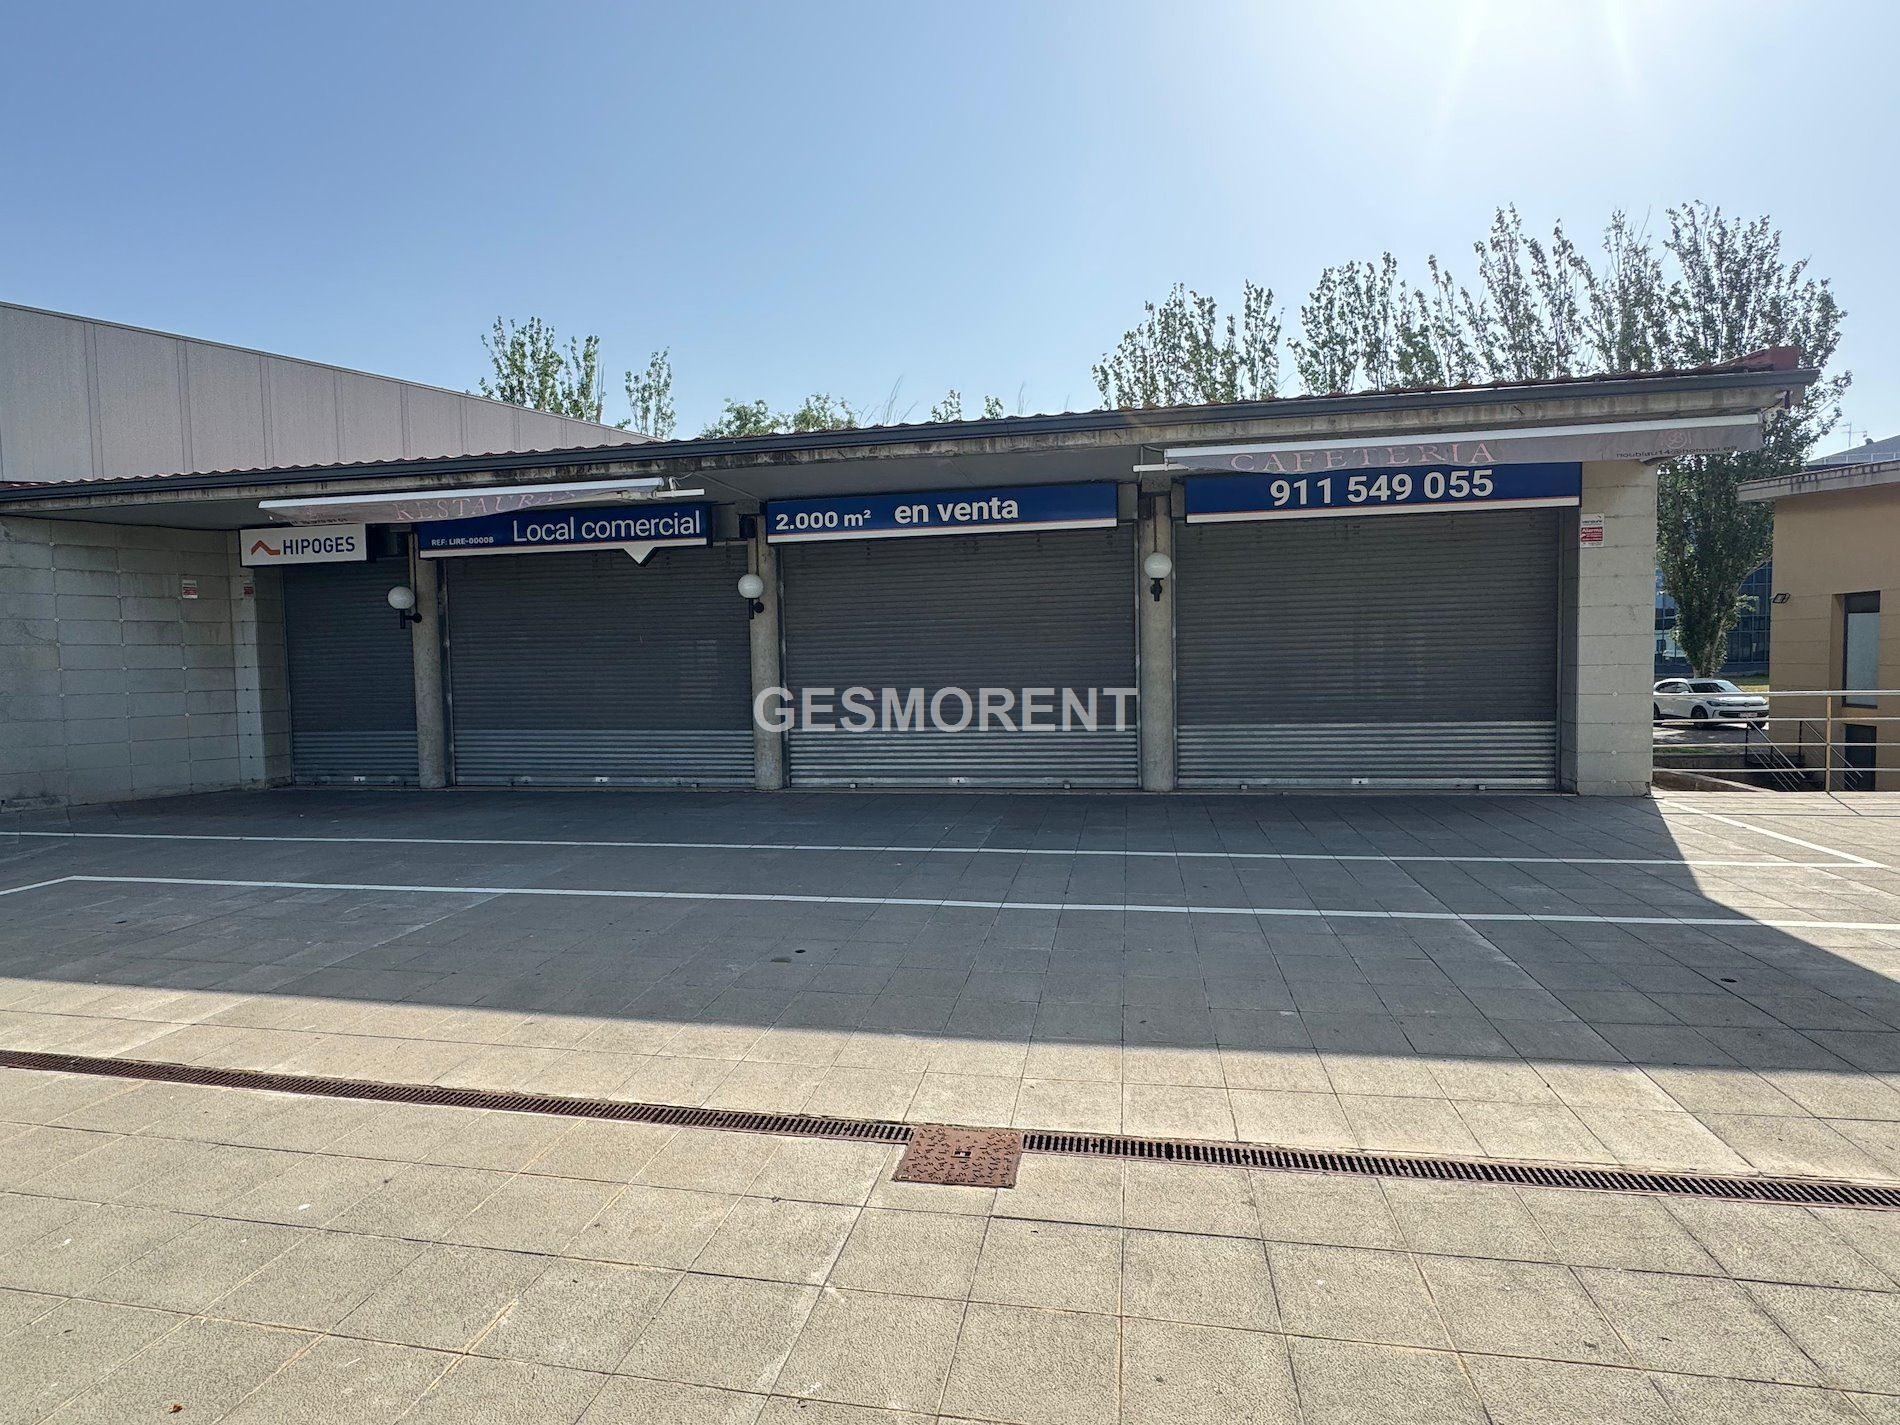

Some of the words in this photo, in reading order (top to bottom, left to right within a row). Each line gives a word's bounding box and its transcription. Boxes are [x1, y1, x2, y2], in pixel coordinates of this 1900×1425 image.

[1230, 442, 1498, 473] CAFETERIA
[1269, 477, 1332, 506] 911
[1347, 474, 1413, 503] 549
[1423, 469, 1494, 498] 055
[513, 516, 575, 542] Local
[581, 510, 701, 539] comercial
[775, 512, 838, 530] 2.000
[894, 504, 930, 524] en
[936, 496, 1019, 522] venta
[283, 536, 355, 556] HIPOGES
[431, 538, 448, 547] REF:
